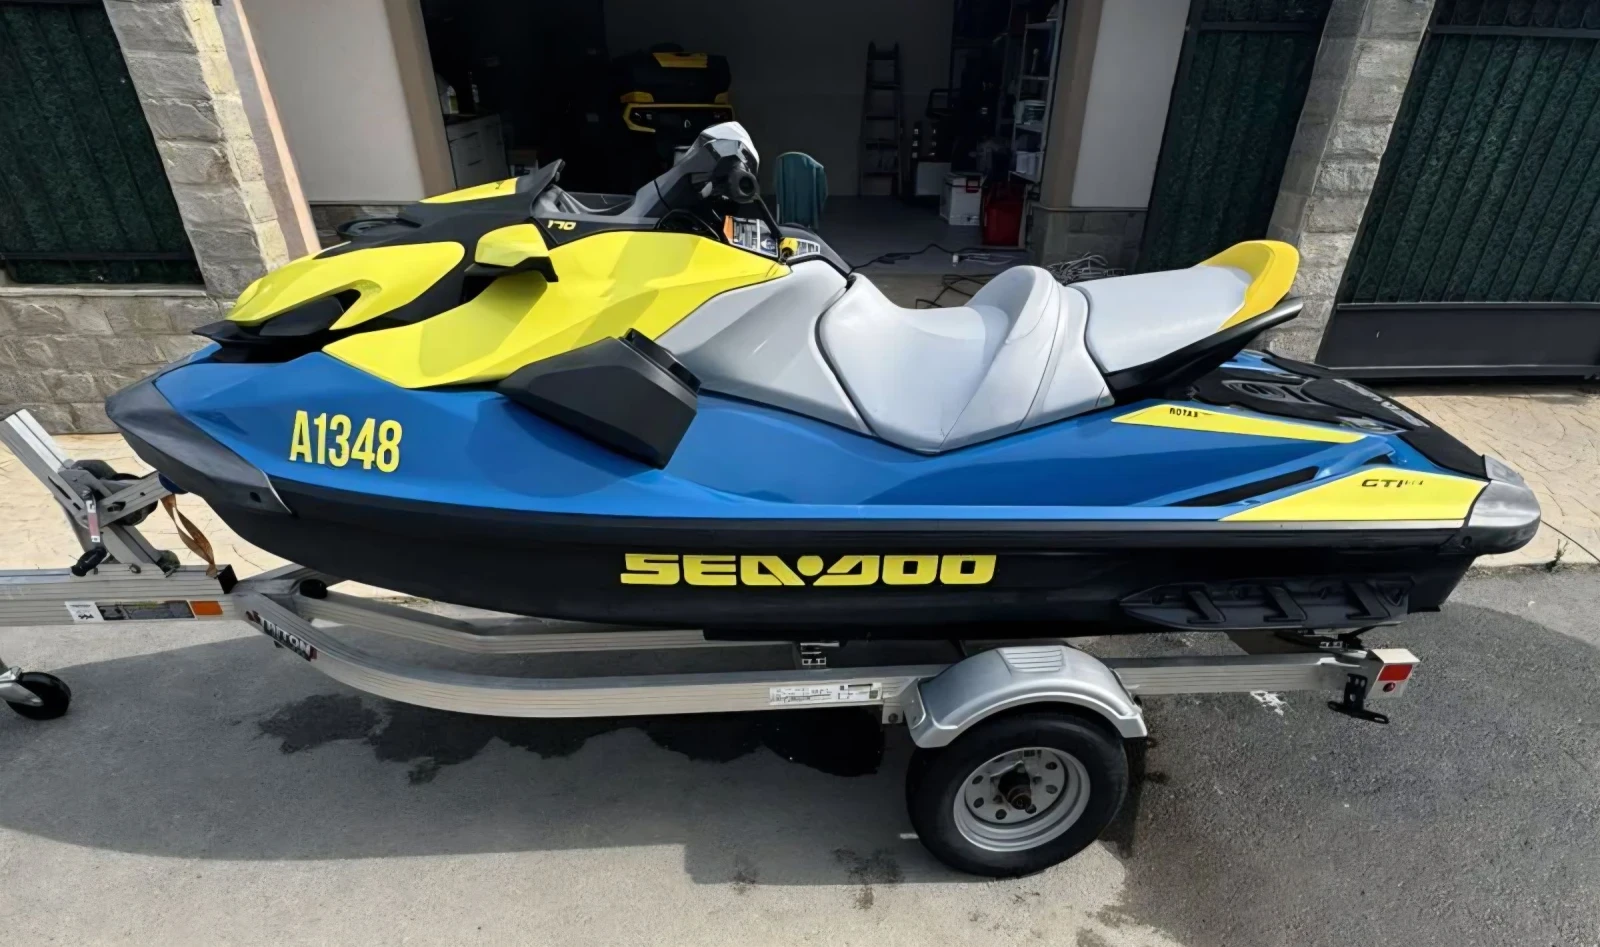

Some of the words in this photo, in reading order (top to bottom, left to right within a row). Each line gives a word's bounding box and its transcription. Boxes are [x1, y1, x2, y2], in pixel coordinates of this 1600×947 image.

[547, 219, 577, 231] 170
[289, 410, 402, 472] A1348
[1360, 478, 1404, 489] GTI
